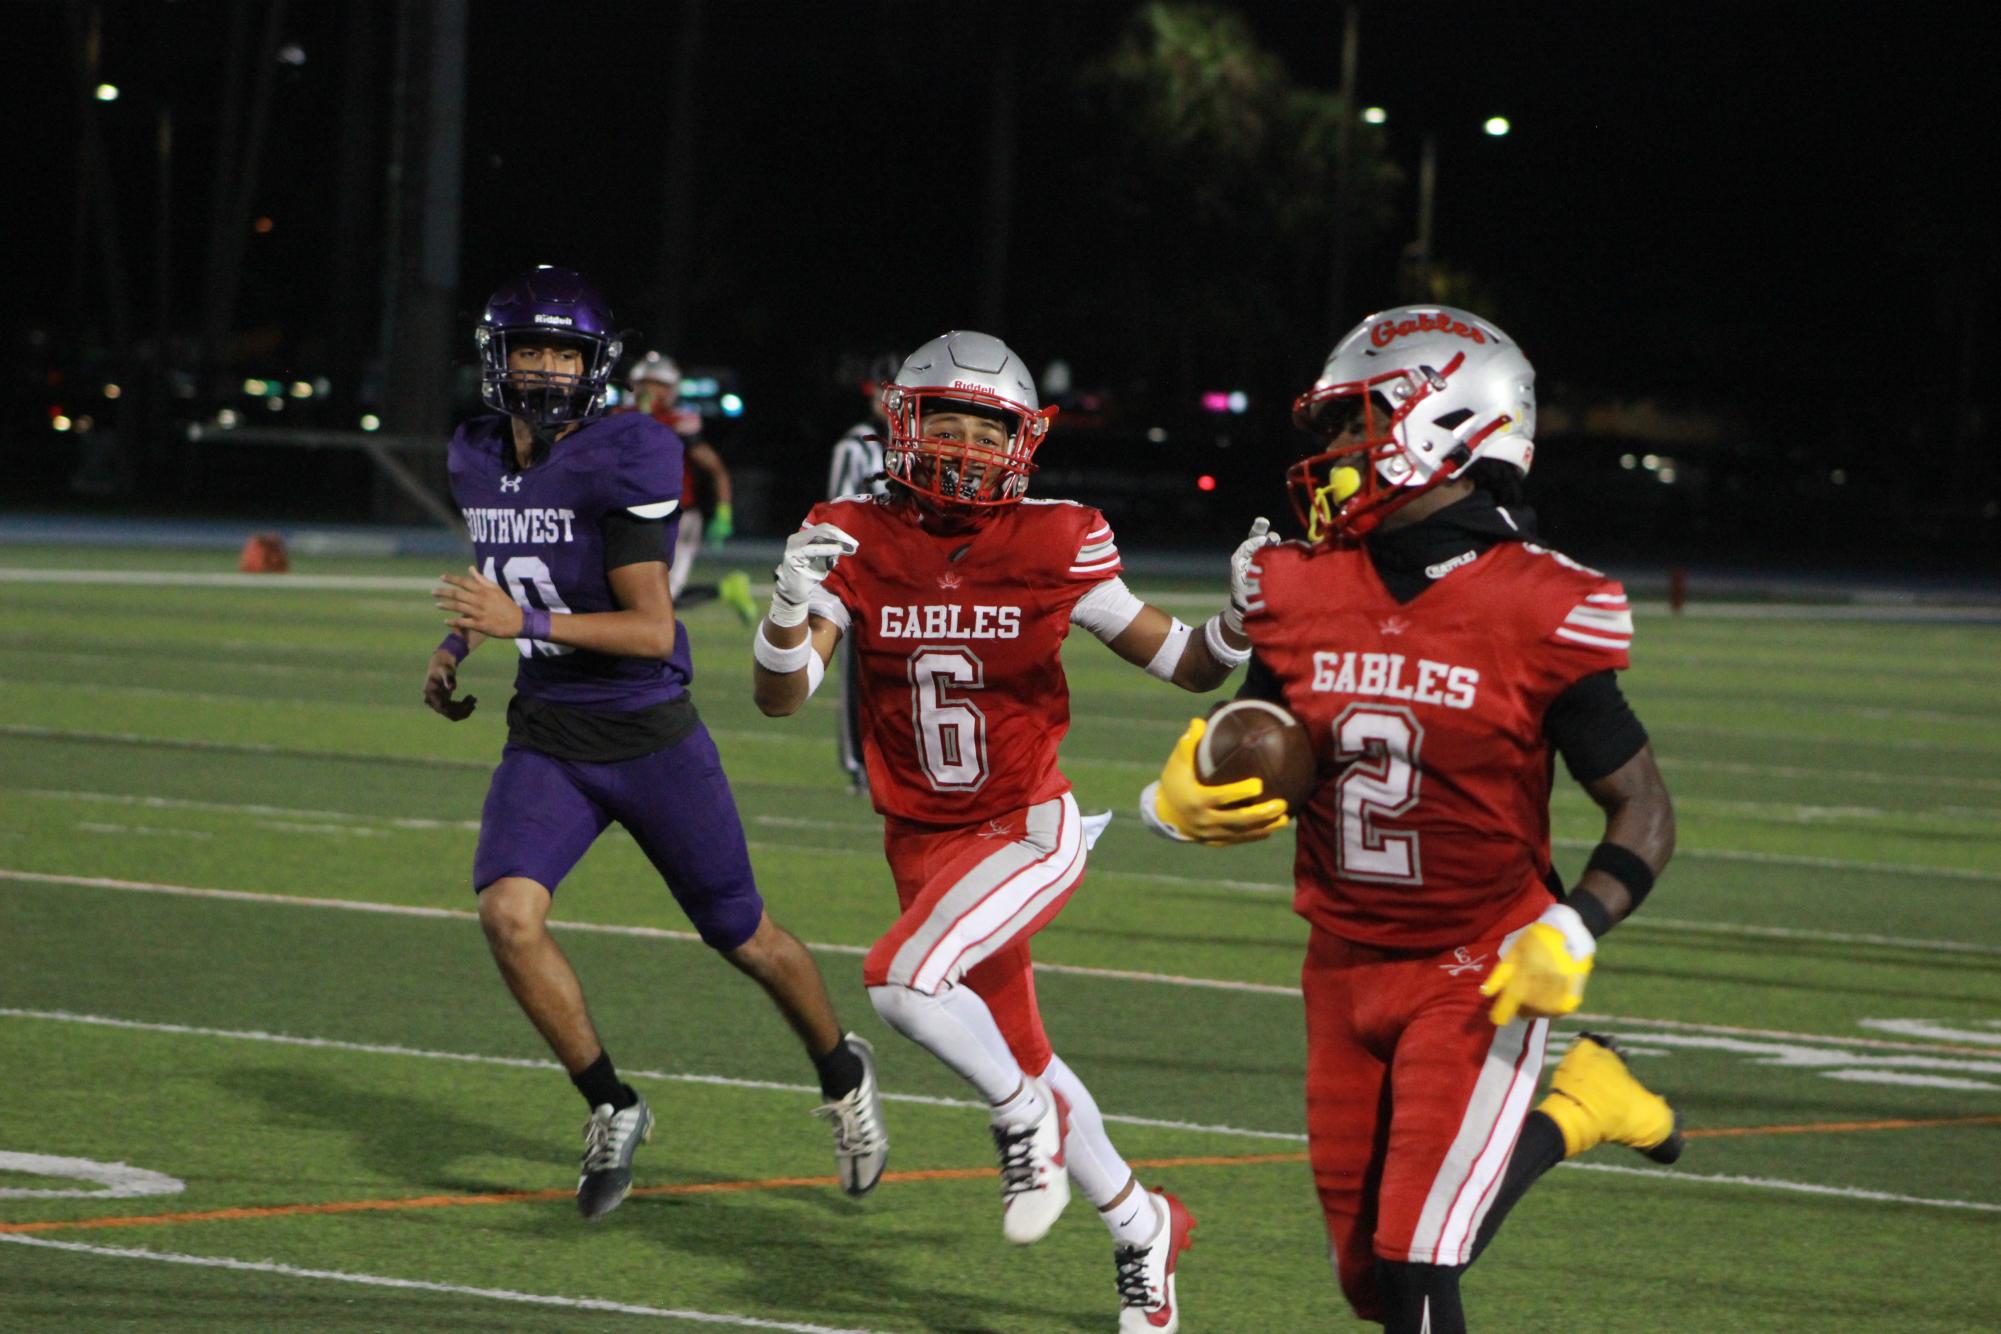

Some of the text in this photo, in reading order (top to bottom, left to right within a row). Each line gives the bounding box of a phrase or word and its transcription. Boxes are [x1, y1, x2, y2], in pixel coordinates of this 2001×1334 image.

[1371, 313, 1486, 348] Gables
[954, 380, 996, 396] Riddell
[879, 603, 1022, 639] GABLES
[1311, 651, 1480, 709] GABLES
[906, 644, 991, 793] 6
[1332, 701, 1425, 886] 2
